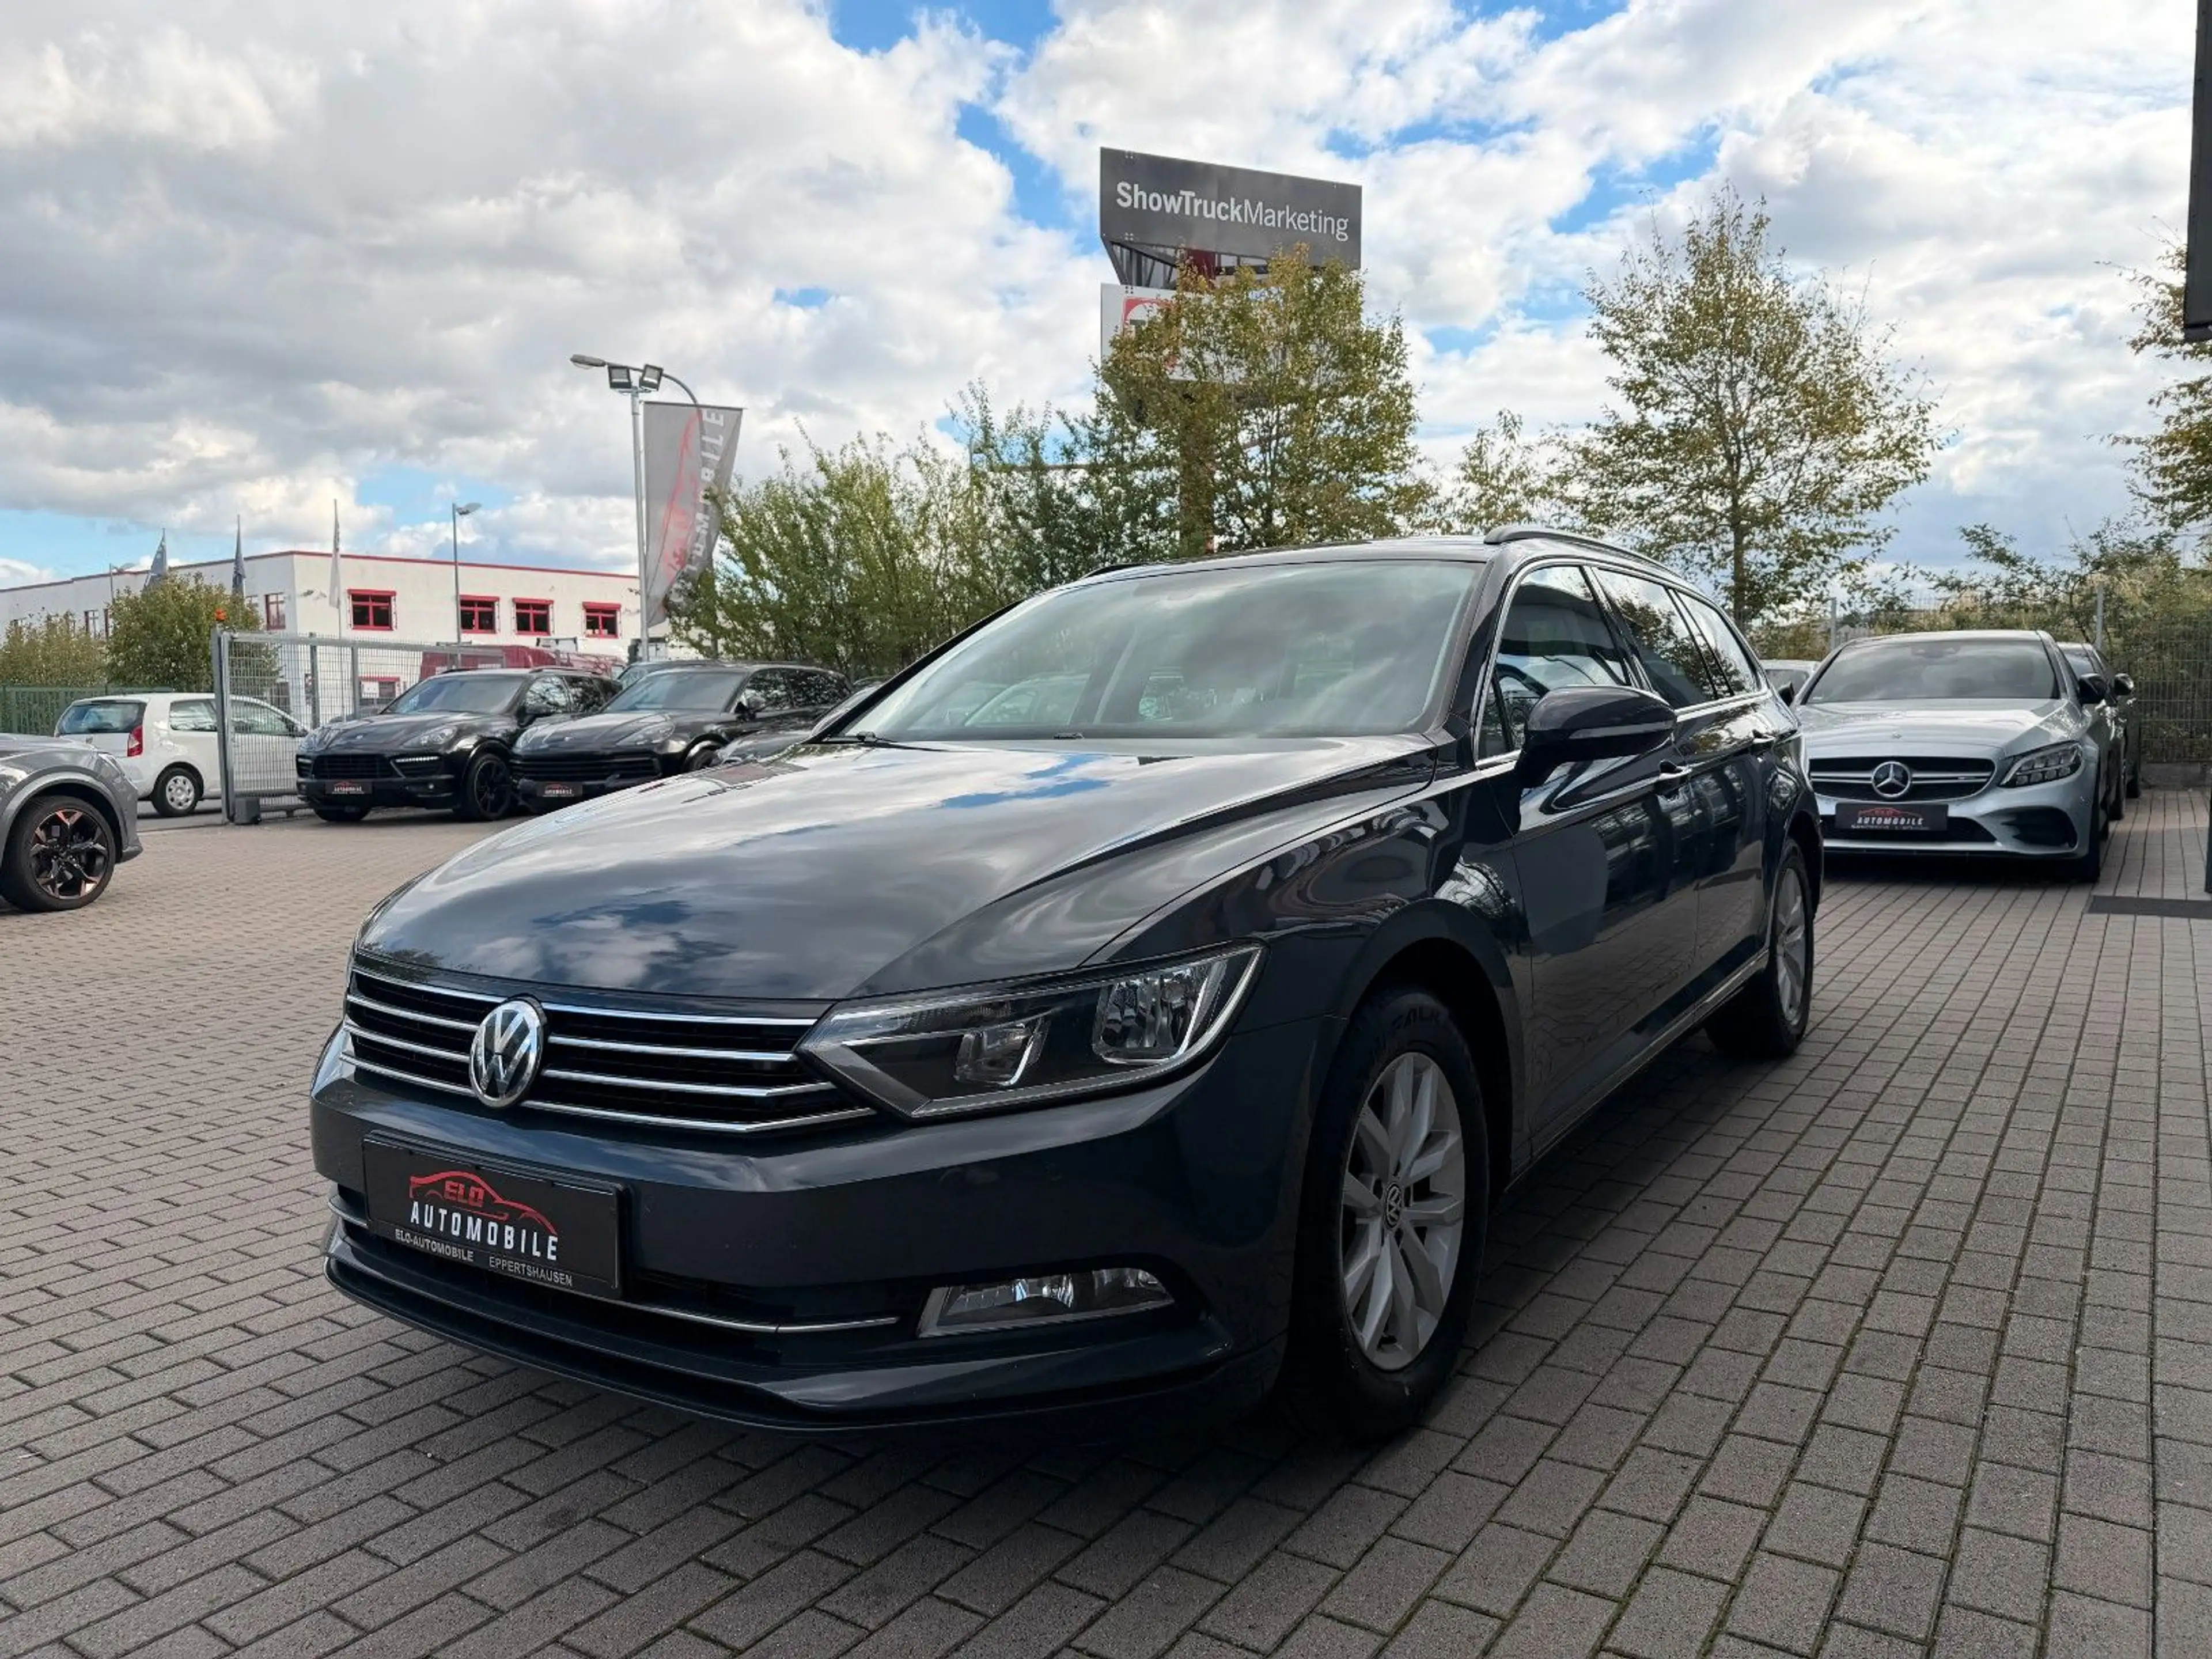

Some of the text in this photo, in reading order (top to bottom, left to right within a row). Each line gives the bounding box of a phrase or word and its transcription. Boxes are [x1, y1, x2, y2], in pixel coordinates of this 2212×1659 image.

[1116, 181, 1349, 241] ShowTruckMarketing
[395, 1228, 573, 1287] ELO-AUTOMOBILE EPPERTSHAUSEN
[410, 1200, 559, 1261] AUTOMOBILE
